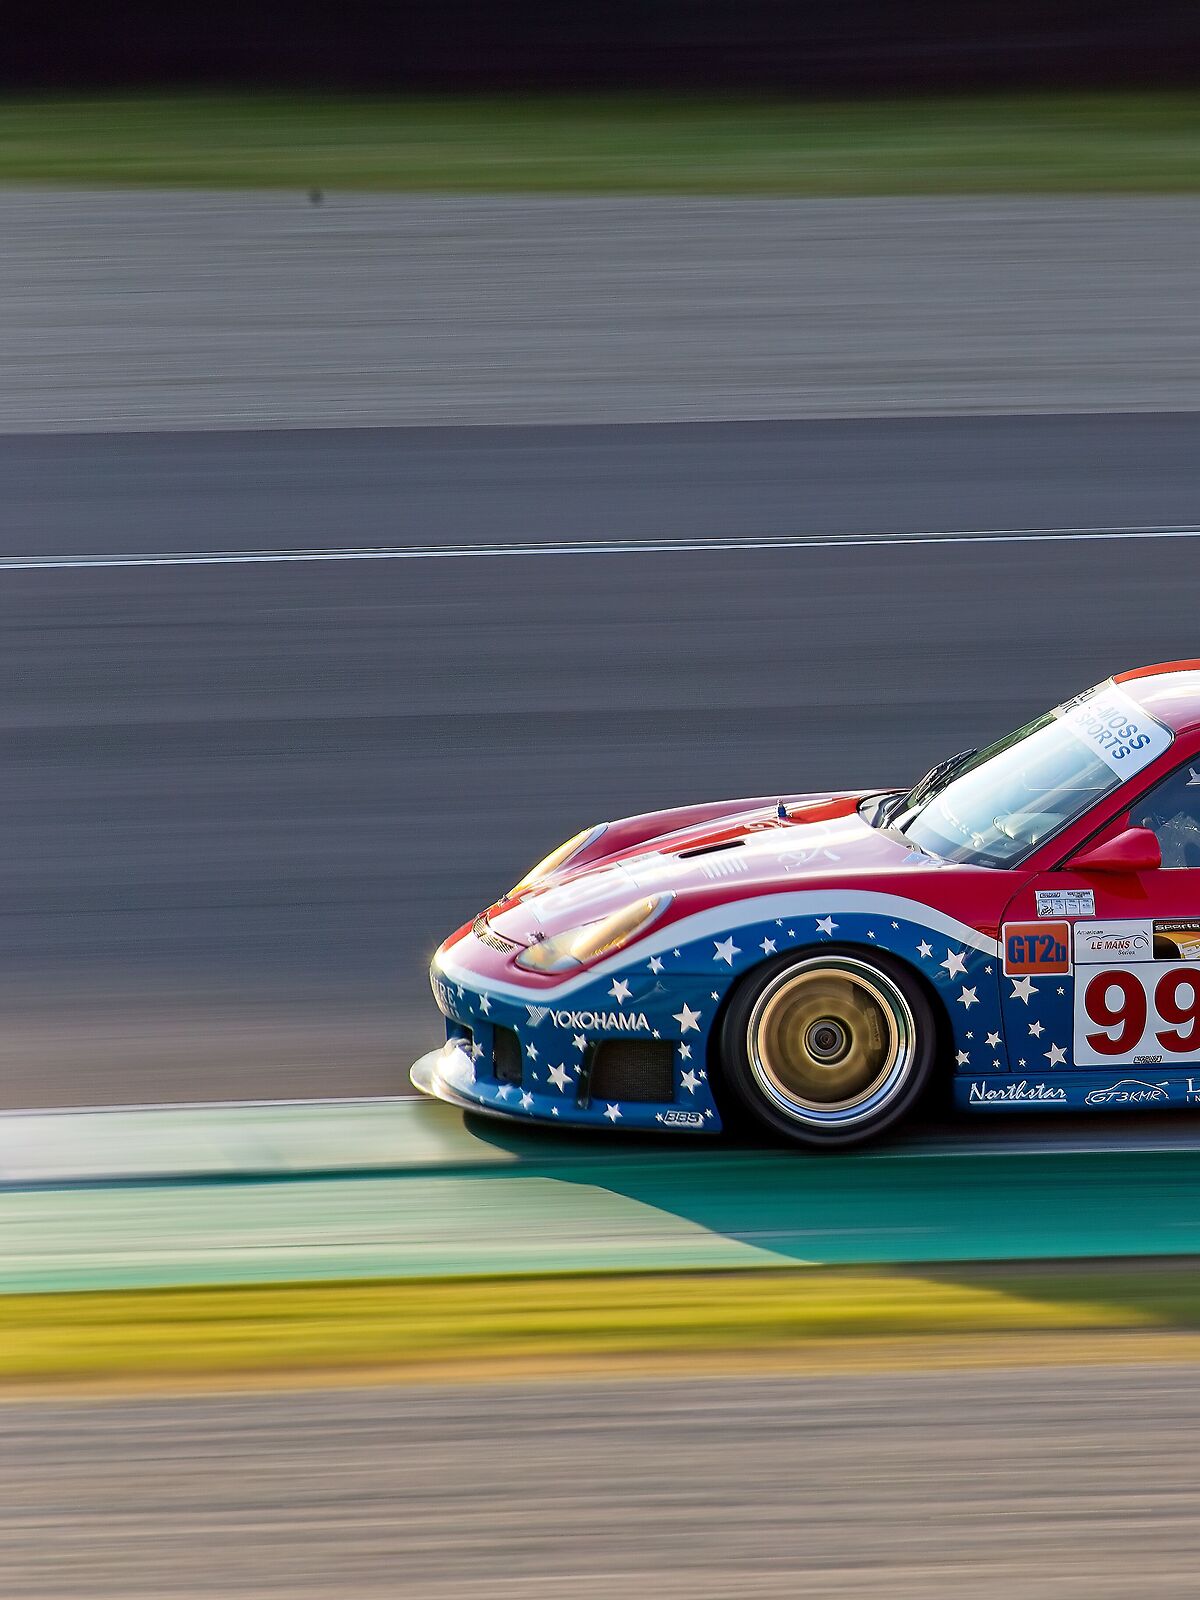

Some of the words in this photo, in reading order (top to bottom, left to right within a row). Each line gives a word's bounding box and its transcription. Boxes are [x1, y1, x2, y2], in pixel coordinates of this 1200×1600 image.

[1091, 941, 1103, 950] LE
[1104, 940, 1131, 950] MANS
[550, 1008, 650, 1032] YOKOHAMA
[969, 1079, 1067, 1100] Northstar
[664, 1111, 702, 1124] BBS
